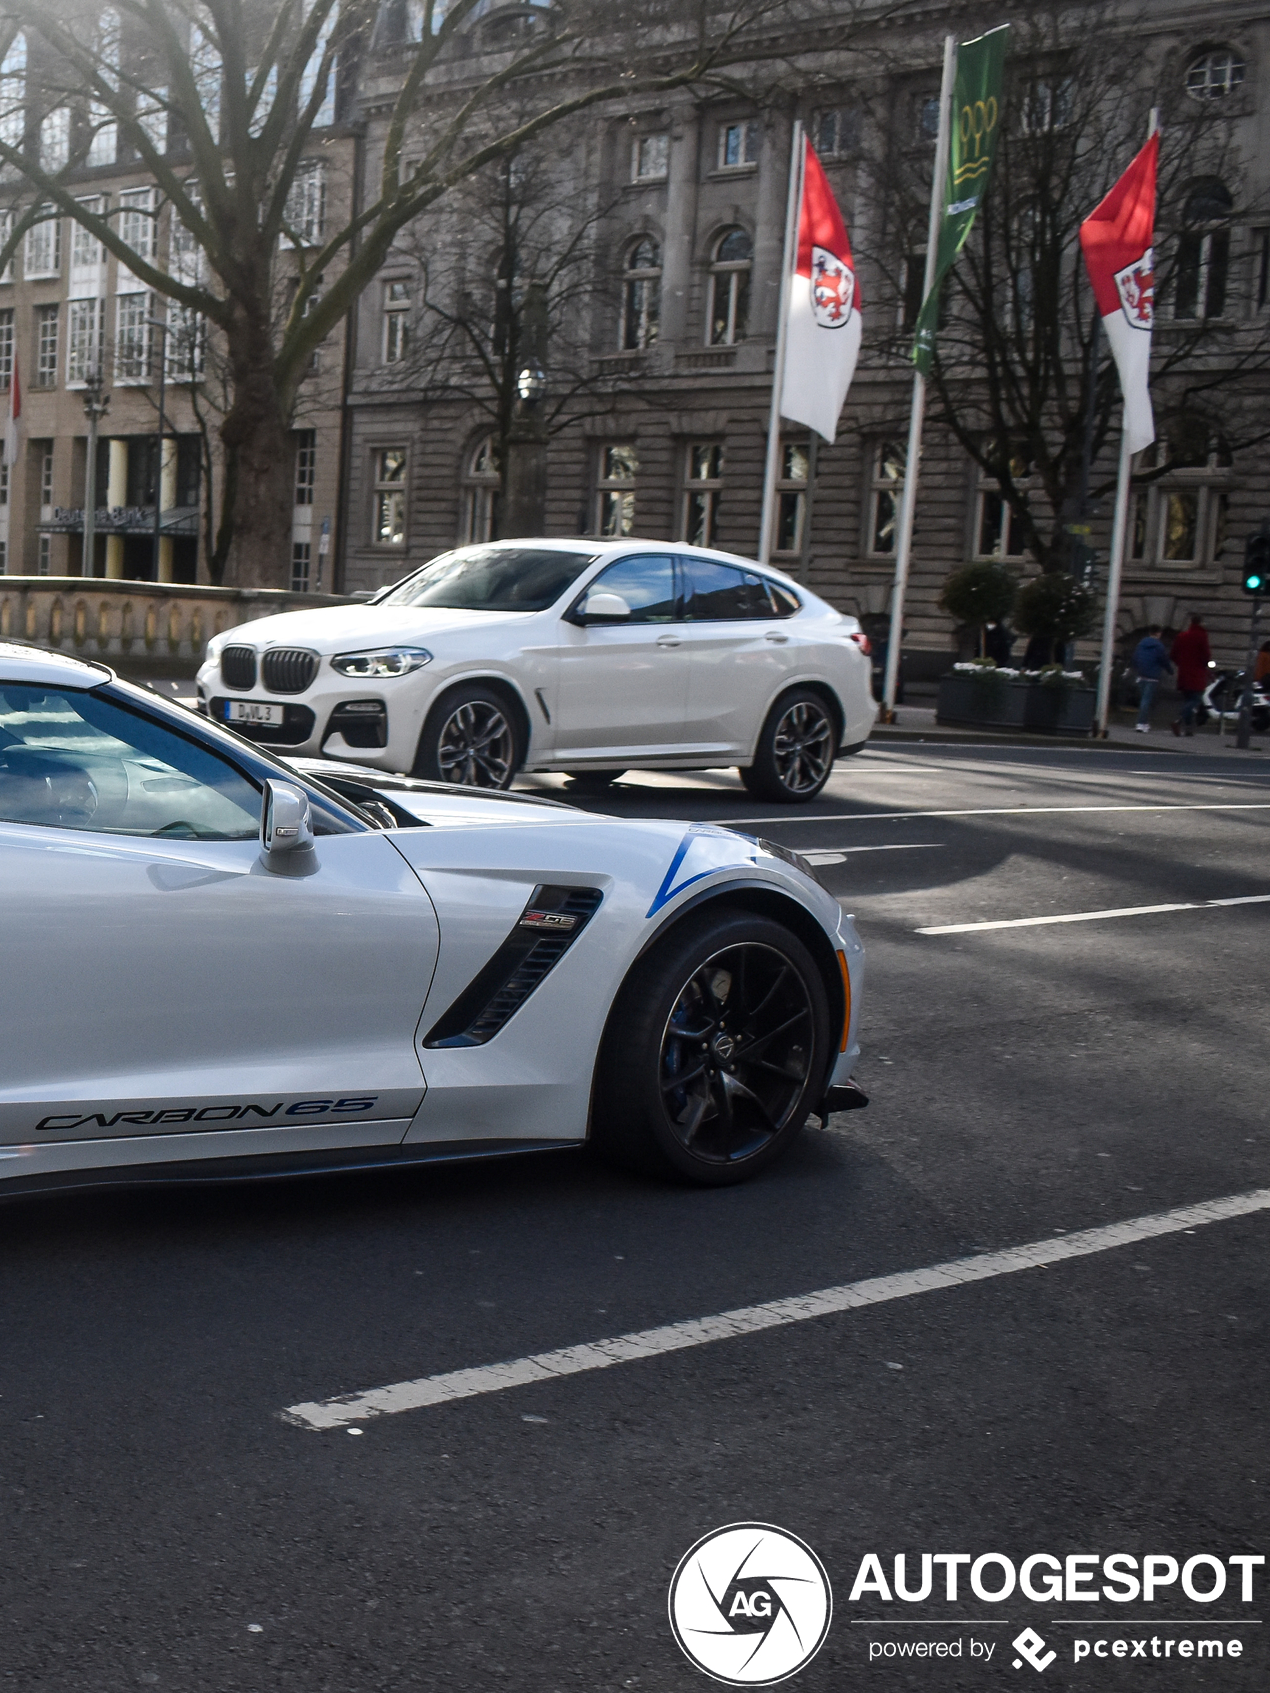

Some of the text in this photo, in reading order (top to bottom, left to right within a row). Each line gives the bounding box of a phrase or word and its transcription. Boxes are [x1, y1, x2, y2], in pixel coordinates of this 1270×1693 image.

[54, 506, 143, 523] Deutshe Bank
[238, 704, 245, 718] D
[265, 706, 271, 721] 3
[523, 912, 576, 924] Z06
